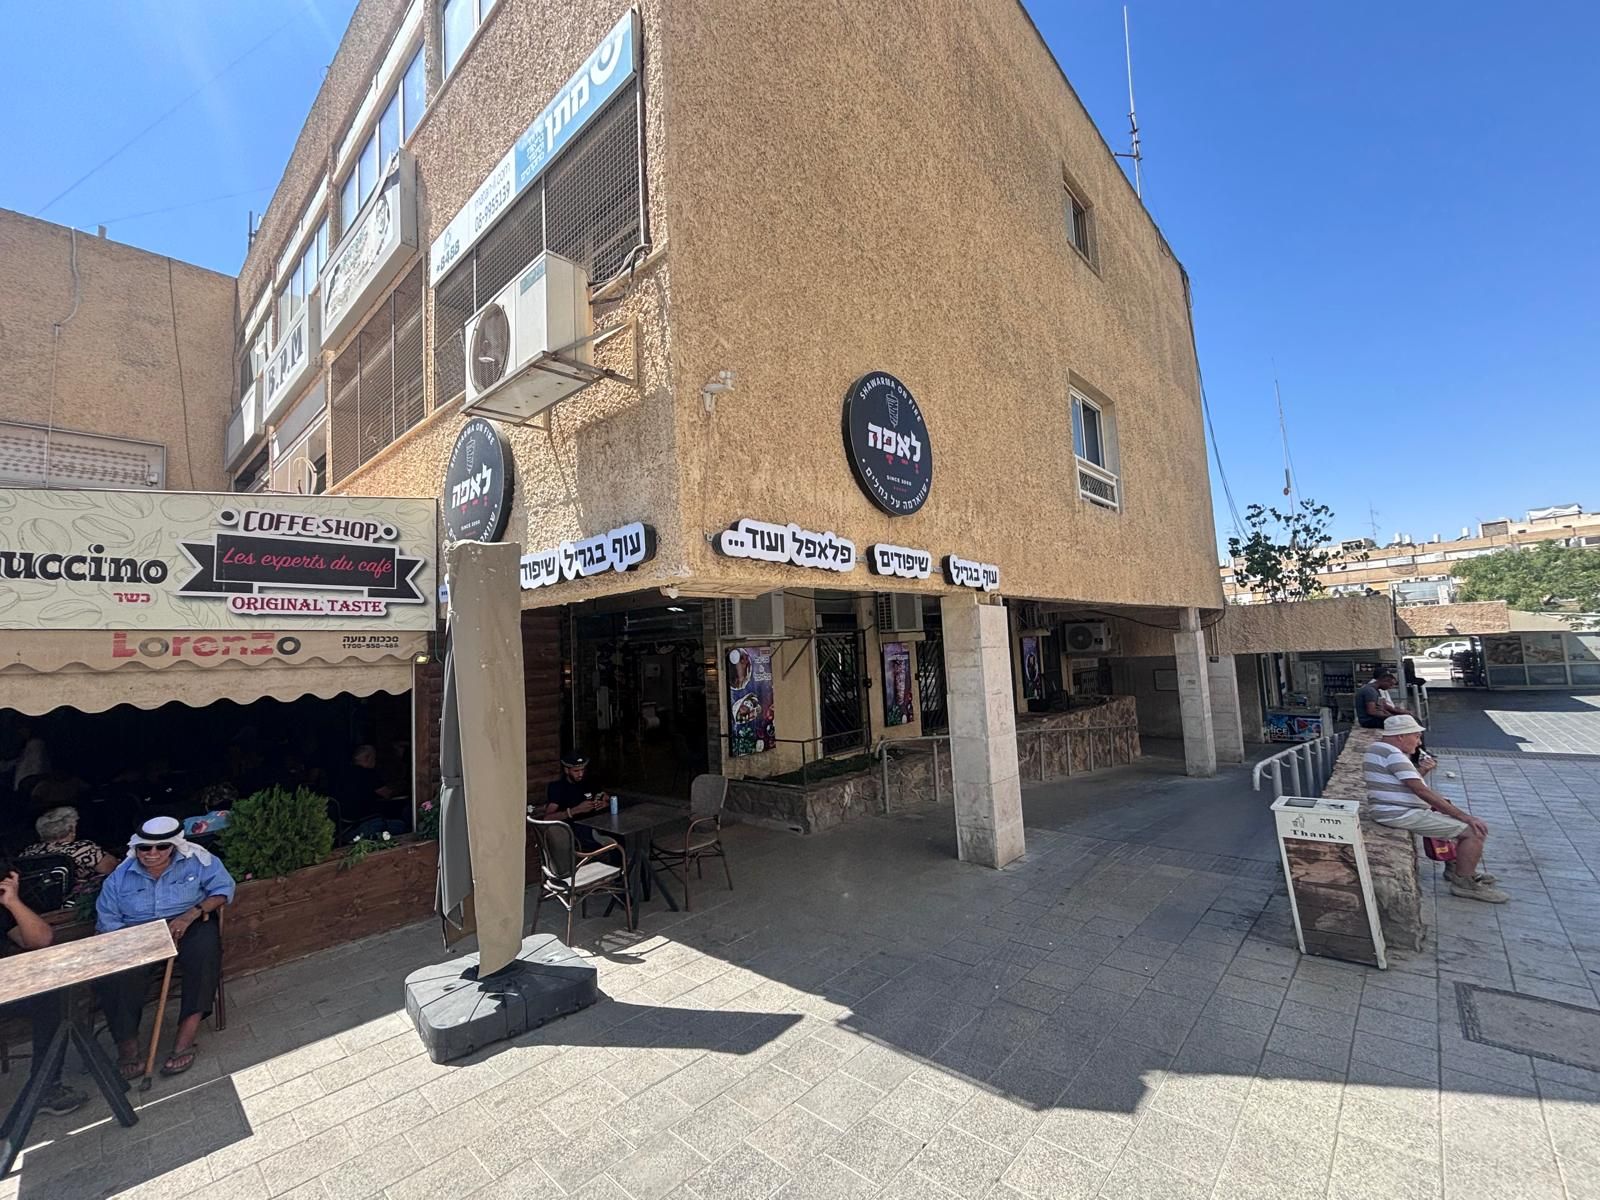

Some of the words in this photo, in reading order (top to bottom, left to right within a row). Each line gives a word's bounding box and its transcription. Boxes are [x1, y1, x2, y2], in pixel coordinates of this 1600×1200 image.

[544, 73, 590, 153] מתן
[859, 376, 896, 400] SHAWARMA
[897, 385, 908, 399] ON
[908, 398, 922, 423] FIRE
[867, 421, 922, 463] לאפה
[451, 462, 493, 509] לאפה
[865, 466, 888, 501] גחלים
[890, 495, 900, 509] על
[243, 510, 315, 532] COFFE
[321, 518, 379, 541] SHOP
[564, 543, 607, 571] בגריל
[612, 532, 641, 564] עוף
[791, 530, 852, 563] פלאפל
[223, 547, 256, 565] Les
[260, 552, 326, 570] experts
[330, 554, 354, 571] du
[358, 558, 393, 579] café
[520, 556, 556, 581] שיפוד
[879, 550, 929, 572] שיפודים
[953, 561, 980, 582] בגריל
[982, 566, 998, 585] עוף
[113, 592, 151, 603] כשר
[232, 596, 324, 612] ORIGINAL
[327, 599, 383, 613] TASTE
[368, 635, 399, 643] סככות
[1290, 828, 1344, 840] Thanks
[1320, 817, 1342, 825] תודה
